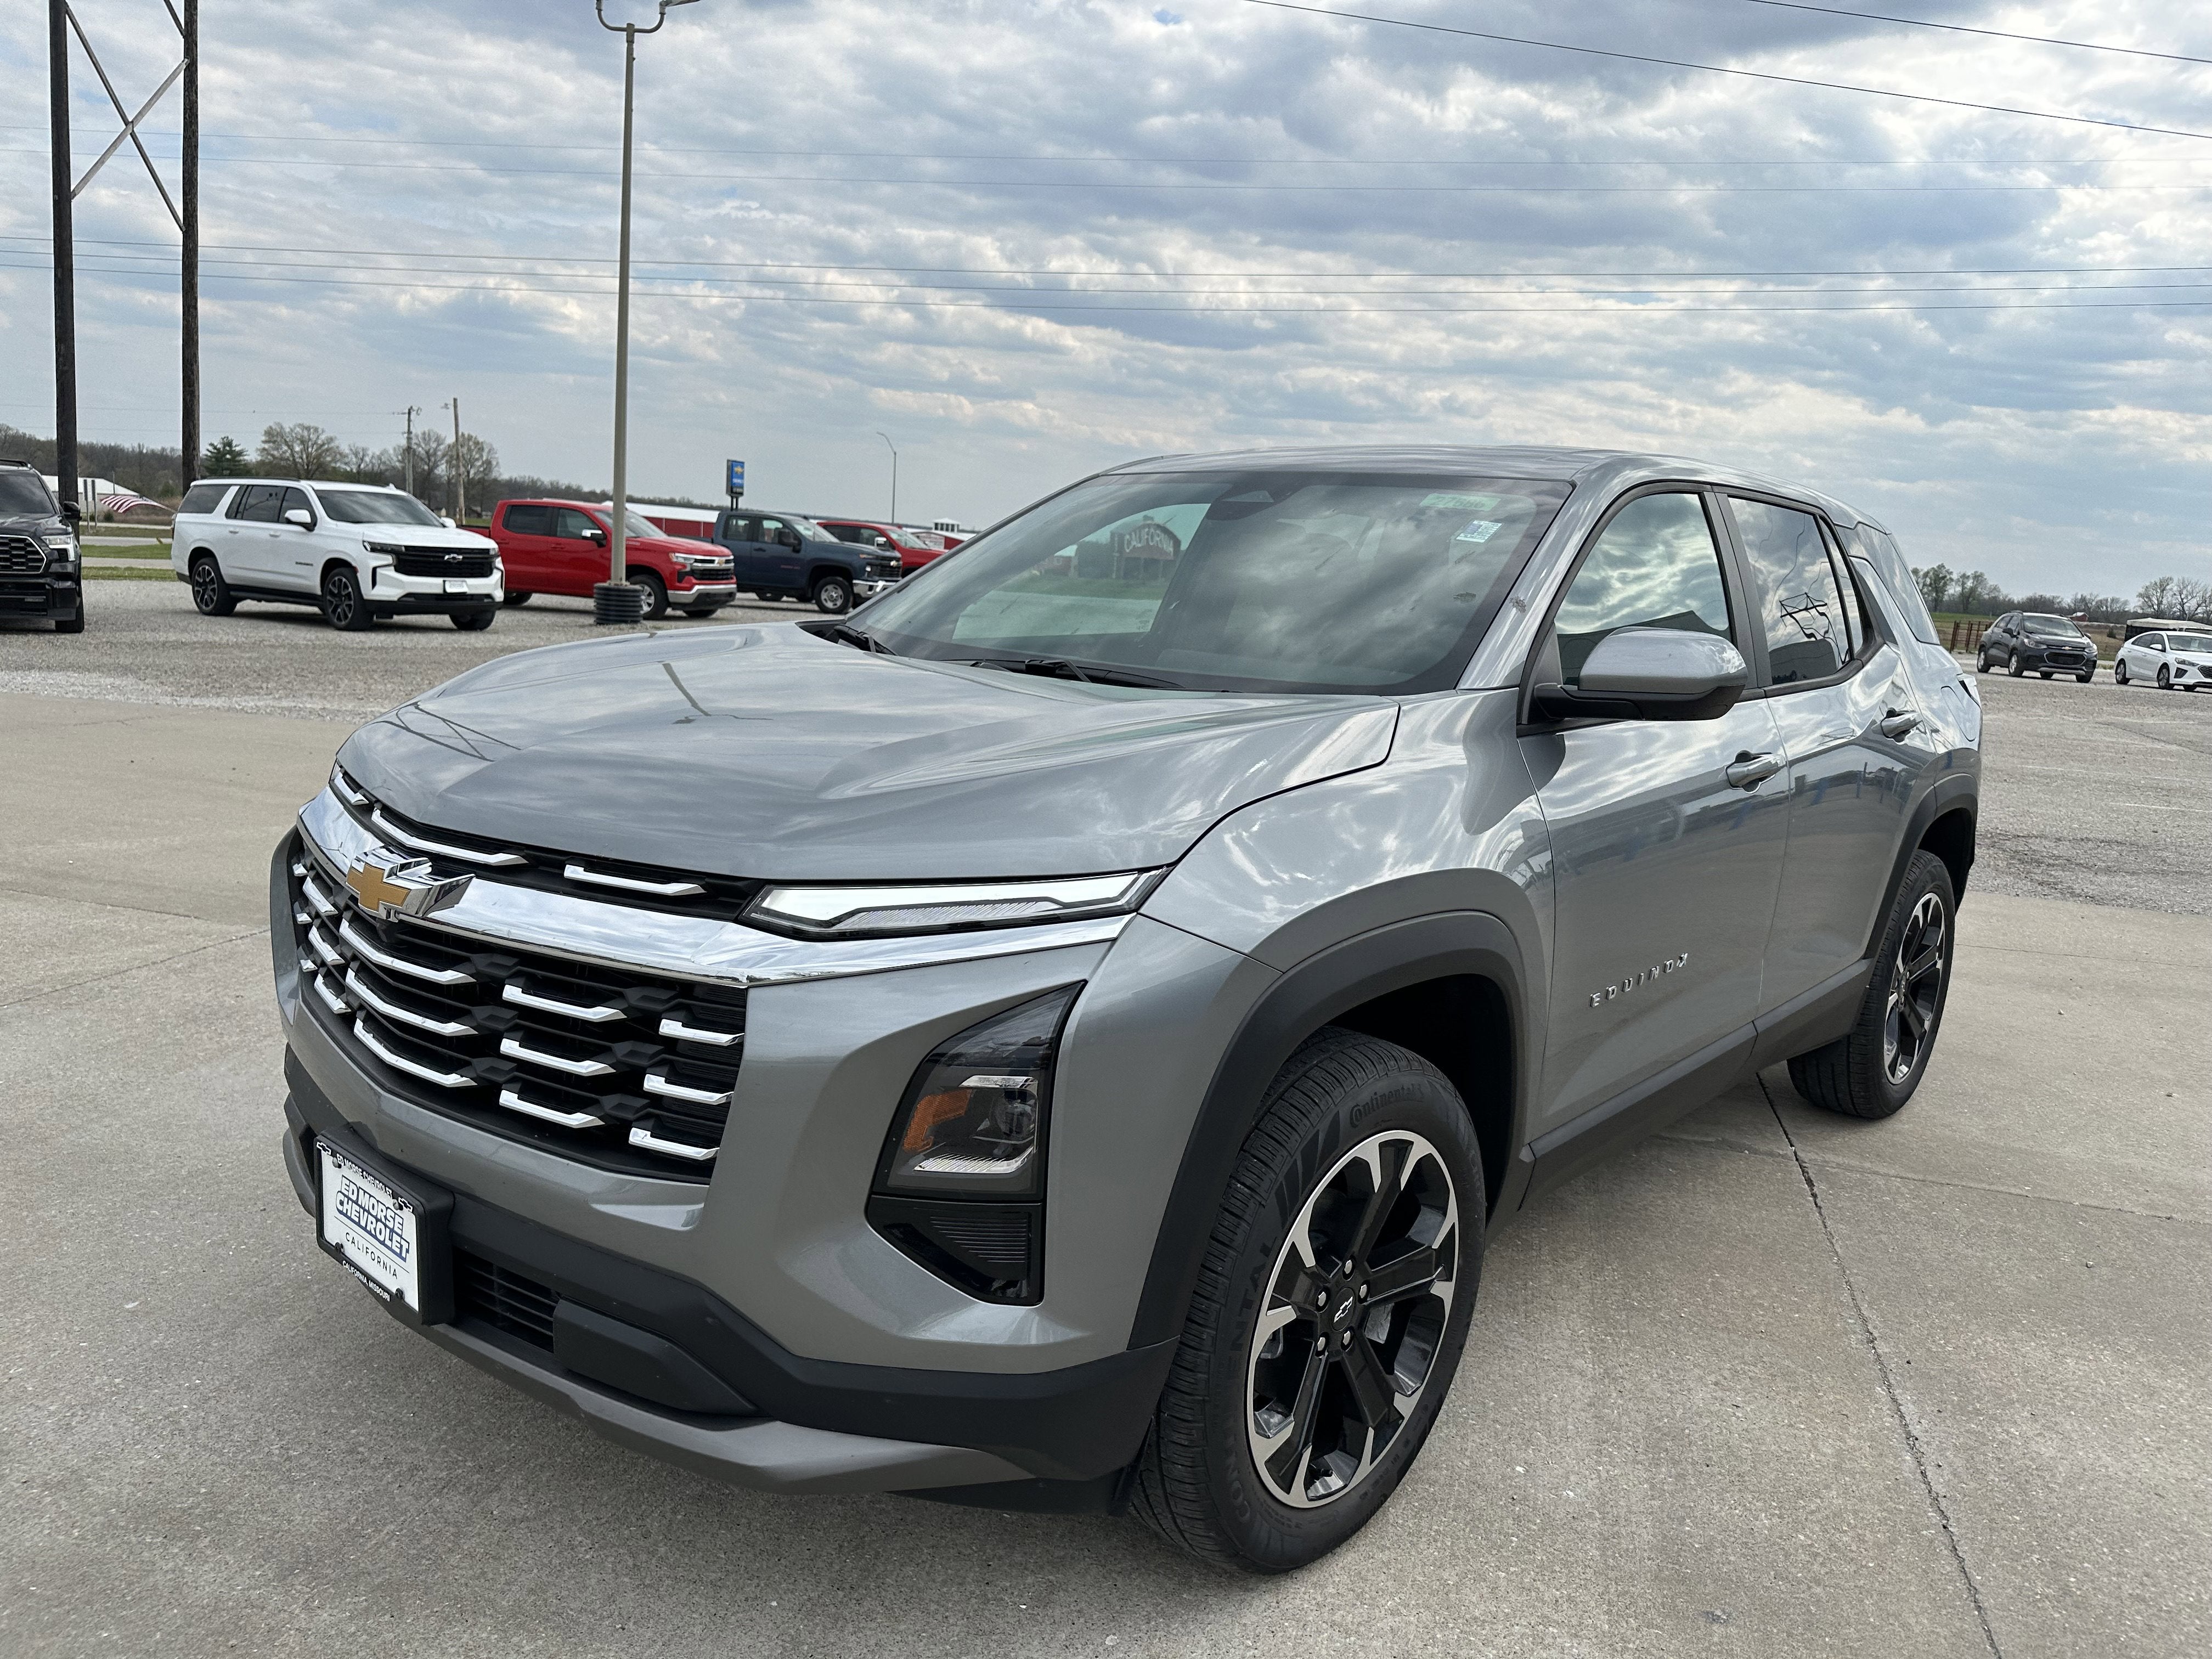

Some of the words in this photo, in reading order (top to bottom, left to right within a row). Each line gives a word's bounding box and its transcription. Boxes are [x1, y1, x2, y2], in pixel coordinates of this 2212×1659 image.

[1590, 952, 1689, 1008] EQUINOX
[336, 1153, 344, 1165] ED
[345, 1159, 363, 1177] MORSE
[363, 1171, 392, 1198] CHEVROLET
[336, 1190, 410, 1262] CHEVROLET
[341, 1175, 358, 1201] ED
[358, 1186, 404, 1235] MORSE
[342, 1260, 368, 1286] CALIFORNIA,
[369, 1280, 390, 1302] MISSOURI
[345, 1232, 398, 1280] CALIFORNIA
